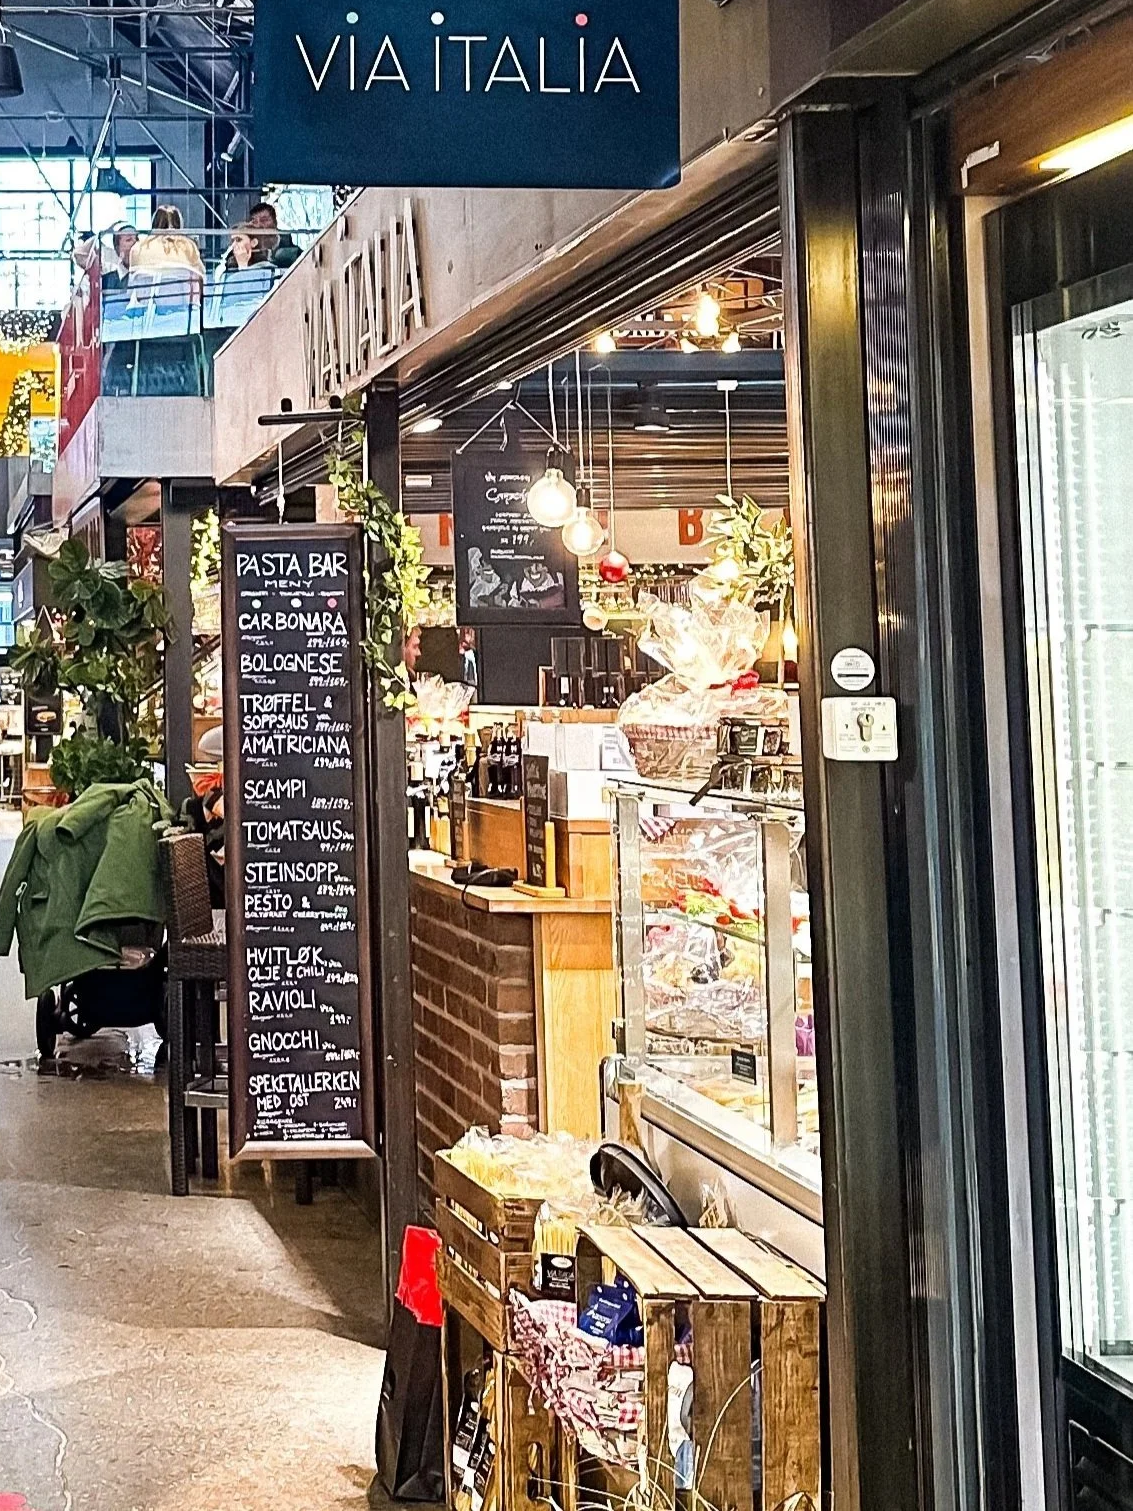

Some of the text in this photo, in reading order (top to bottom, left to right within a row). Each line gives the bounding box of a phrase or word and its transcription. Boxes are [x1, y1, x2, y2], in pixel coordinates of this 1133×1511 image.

[236, 552, 349, 578] PASTA BAR
[264, 579, 313, 588] MENY
[238, 612, 348, 635] CARBONARA
[240, 652, 343, 675] BOLOGNESE
[239, 693, 333, 713] TRØFFEL &
[242, 713, 309, 730] SOPPSAUS
[241, 734, 351, 756] AMATRICIANA
[243, 778, 306, 800] SCAMPI
[241, 819, 343, 842] TOMATSAUS
[244, 861, 339, 883] STEINSOPP
[244, 893, 293, 912] PESTO
[301, 895, 311, 909] &
[247, 965, 325, 982] OLJE & CHILI
[248, 988, 316, 1014] RAVIOLI
[248, 1029, 320, 1052] GNOCCHI
[248, 1070, 361, 1096] SPEKETALLERKEN
[256, 1092, 310, 1111] MED OST
